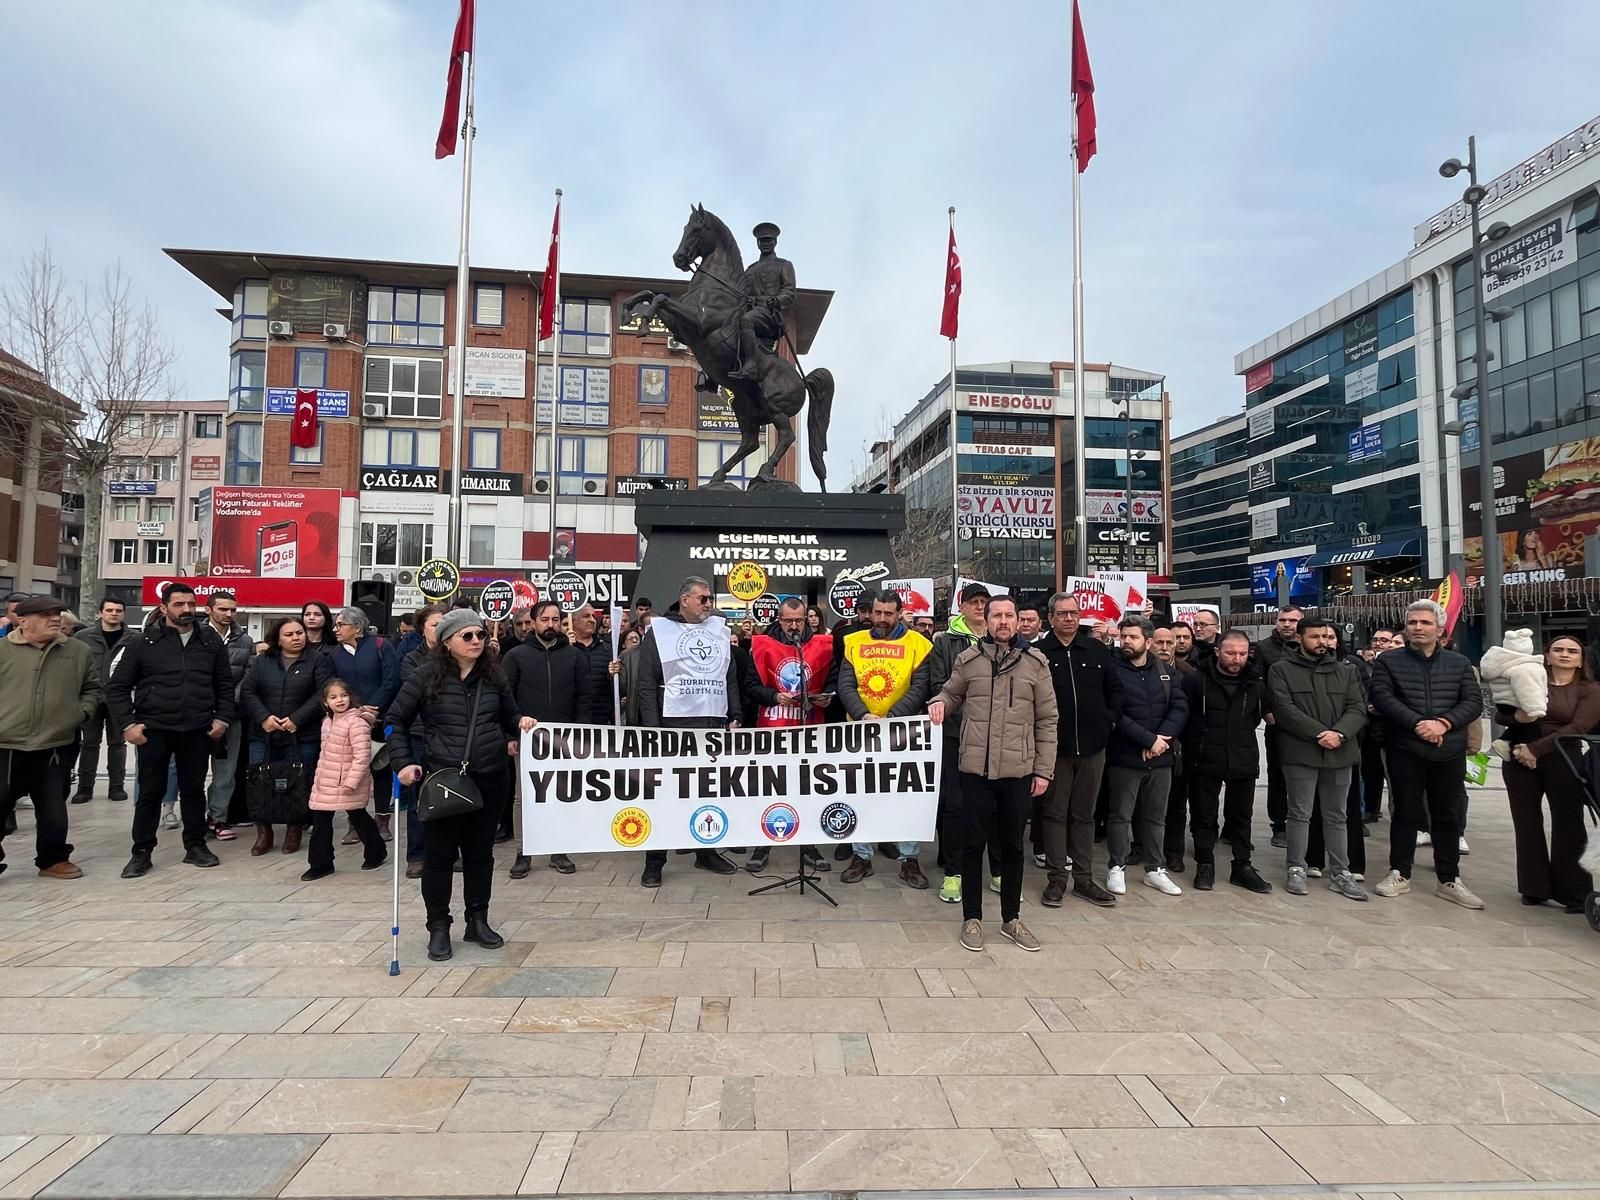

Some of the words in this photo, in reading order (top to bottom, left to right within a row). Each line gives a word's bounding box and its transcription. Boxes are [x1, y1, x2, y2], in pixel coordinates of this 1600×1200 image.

[1438, 168, 1526, 229] BUGER
[1490, 224, 1556, 263] DİYETİSYEN
[1528, 236, 1552, 256] EZGİ
[969, 394, 1052, 410] ENESOĞLU
[976, 446, 1005, 454] TERAS
[1008, 447, 1032, 455] CAFE
[363, 470, 437, 489] ÇAĞLAR
[216, 491, 240, 499] Değişen
[959, 486, 971, 494] SİZ
[973, 487, 1003, 495] BİZEDE
[216, 499, 240, 507] Uygun
[975, 497, 1053, 514] YAVUZ
[959, 514, 1009, 527] SÜRÜCÜ
[1013, 517, 1054, 528] KURSU
[1352, 534, 1381, 545] EATFORD
[263, 550, 280, 567] 20
[282, 550, 294, 561] GB
[690, 547, 770, 560] KAYITSIZ
[774, 549, 847, 561] ŞARTSIZ
[1330, 550, 1374, 564] EATFORD
[1530, 569, 1566, 583] KING
[194, 585, 236, 595] dafone
[420, 580, 453, 592] DOKUNMA
[732, 582, 762, 593] DOKUNMA
[888, 582, 911, 590] BOYUN
[1074, 581, 1105, 593] BOYUN
[484, 592, 512, 600] ŞİDDETE
[1178, 606, 1200, 614] BOYUN
[864, 646, 900, 656] GÖREVLİ
[680, 679, 724, 688] HÜRRİYETÇİ
[679, 687, 711, 695] EĞİTİM
[532, 728, 698, 760] OKULLARDA
[705, 727, 818, 762] ŞİDDETE
[826, 723, 881, 753] DUR
[890, 720, 932, 752] DE!
[529, 768, 663, 803] YUSUF
[672, 760, 787, 799] TEKİN
[800, 757, 935, 796] İSTİFA!
[615, 810, 636, 825] EĞİTİM
